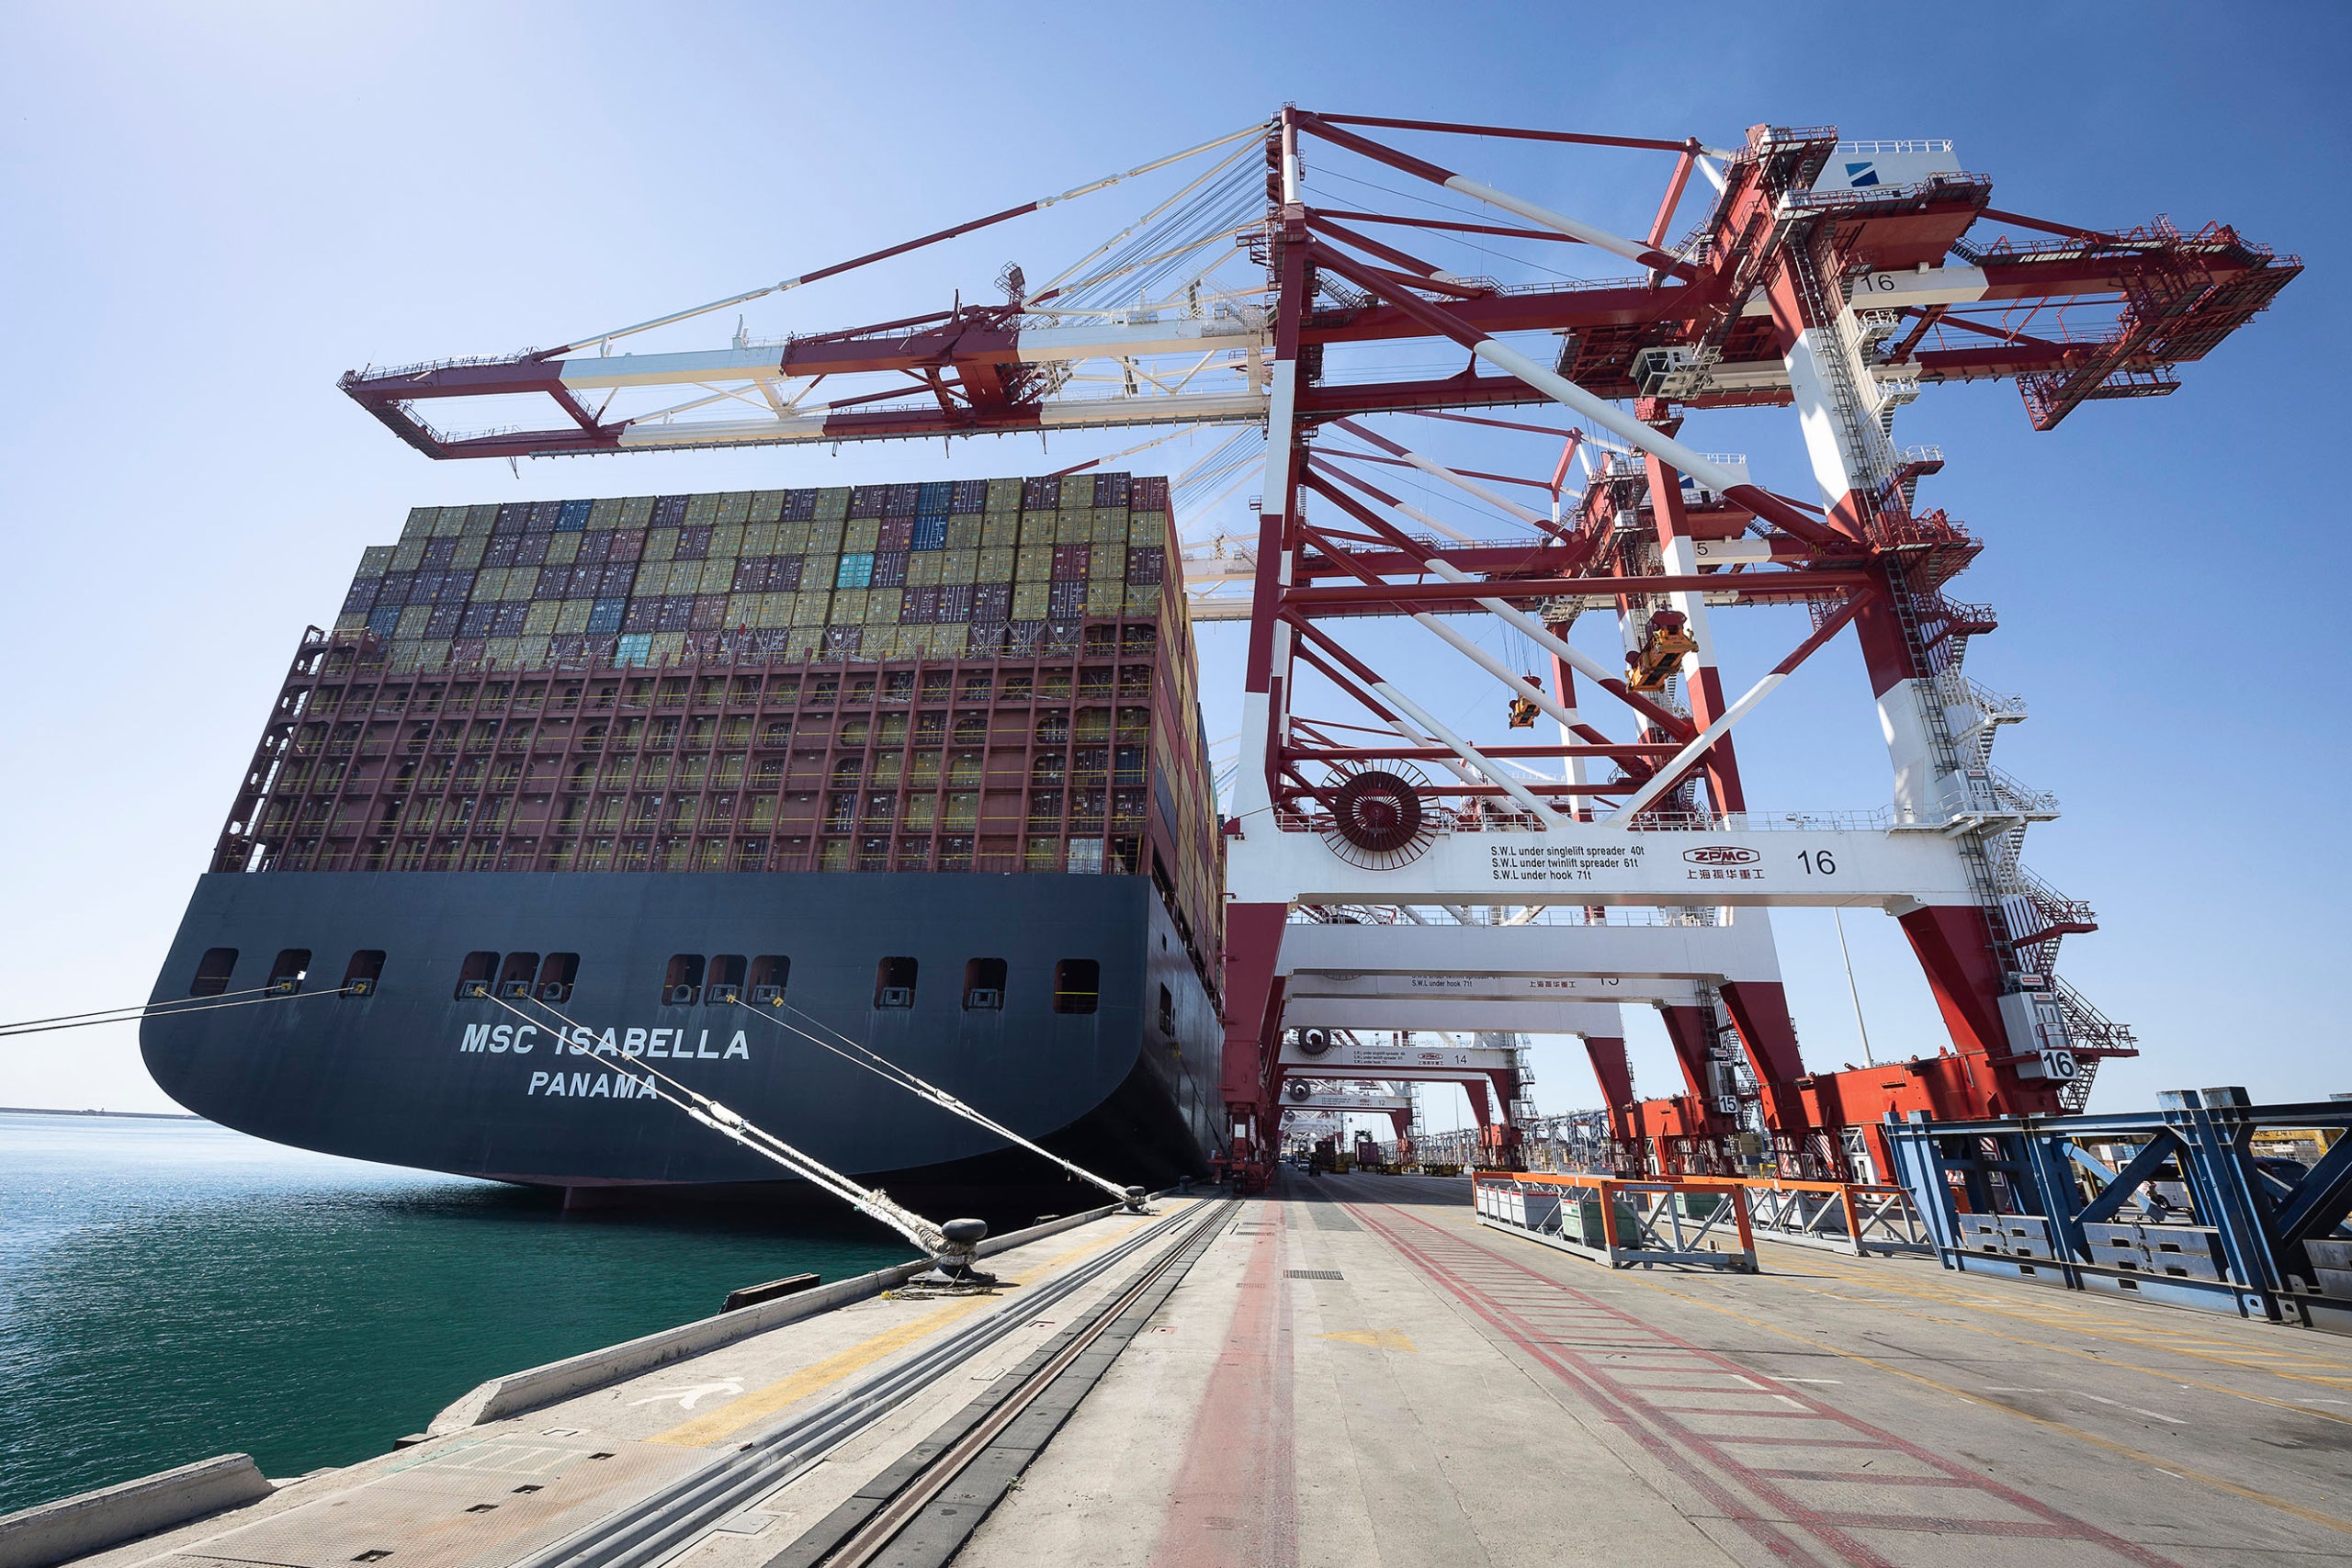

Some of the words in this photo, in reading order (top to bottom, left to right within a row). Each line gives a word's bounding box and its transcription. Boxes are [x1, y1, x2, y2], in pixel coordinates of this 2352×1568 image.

[1860, 274, 1894, 291] 16
[1697, 542, 1708, 555] 5
[1490, 846, 1517, 856] S.W.L
[1519, 846, 1544, 856] under
[1546, 846, 1584, 858] singlelift
[1586, 846, 1625, 858] spreader
[1630, 846, 1645, 856] 40t
[1694, 852, 1750, 861] ZPMC
[1491, 858, 1518, 868] S.W.L
[1520, 858, 1545, 868] under
[1547, 858, 1577, 868] twinlift
[1579, 858, 1619, 870] spreader
[1623, 858, 1638, 868] 61t
[1797, 850, 1836, 874] 16
[1493, 870, 1519, 880] S.W.L
[1521, 870, 1546, 880] under
[1549, 870, 1573, 880] hook
[1577, 870, 1591, 880] 71t
[1687, 869, 1765, 880] 上海振华重工
[460, 1023, 537, 1055] MSC
[555, 1026, 750, 1060] ISABELLA
[1454, 1055, 1467, 1064] 14
[2043, 1051, 2075, 1077] 16
[527, 1071, 659, 1100] PANAMA
[1720, 1097, 1736, 1111] 15
